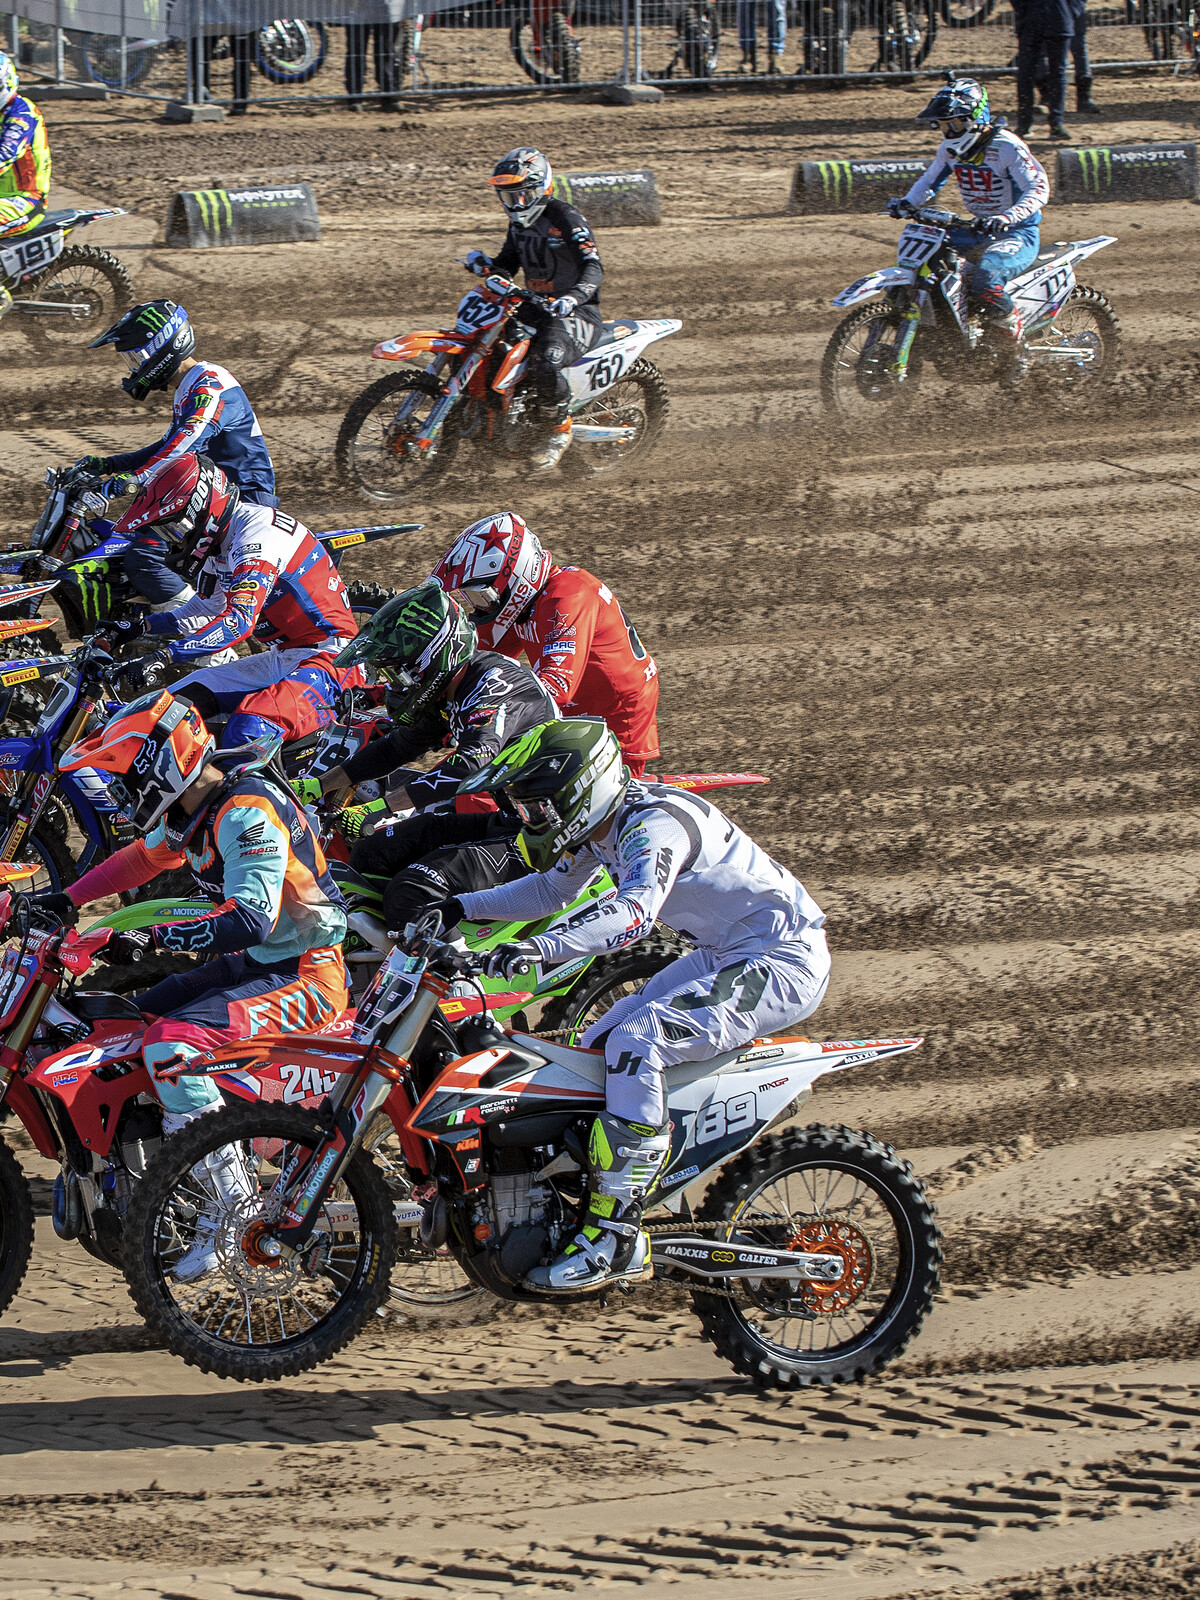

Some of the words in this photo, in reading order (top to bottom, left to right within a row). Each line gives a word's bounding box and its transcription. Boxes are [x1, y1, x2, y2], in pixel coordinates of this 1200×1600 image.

[1112, 150, 1187, 162] MONSTER
[852, 162, 927, 173] MONSTER
[570, 174, 648, 187] MONSTER
[954, 168, 992, 192] FLY
[228, 188, 305, 202] MONSTER
[15, 235, 55, 271] 191
[458, 296, 500, 328] 152
[559, 318, 594, 348] FLY
[146, 353, 173, 378] MONSTER
[585, 354, 623, 391] 152
[187, 468, 214, 518] 100%
[334, 535, 363, 547] PIRELLI
[502, 529, 524, 578] OAKLEY
[499, 583, 529, 626] HEXIS
[5, 668, 37, 684] PIRELLI
[417, 671, 445, 705] MONSTER
[167, 707, 181, 724] FOX
[238, 839, 276, 848] HONDA
[655, 847, 673, 894] KTM
[173, 908, 211, 916] MOTOREX
[558, 962, 585, 979] MOTOREX
[845, 1051, 879, 1063] MAXXIS
[206, 1062, 238, 1071] MAXXIS
[53, 1072, 79, 1087] HRC
[758, 1077, 789, 1092] MXGP
[682, 1090, 757, 1150] 189
[456, 1138, 480, 1151] KTM
[305, 1152, 336, 1198] MOTOREX
[369, 1244, 379, 1284] MAXXIS
[665, 1246, 709, 1259] MAXXIS
[738, 1253, 779, 1266] GALFER
